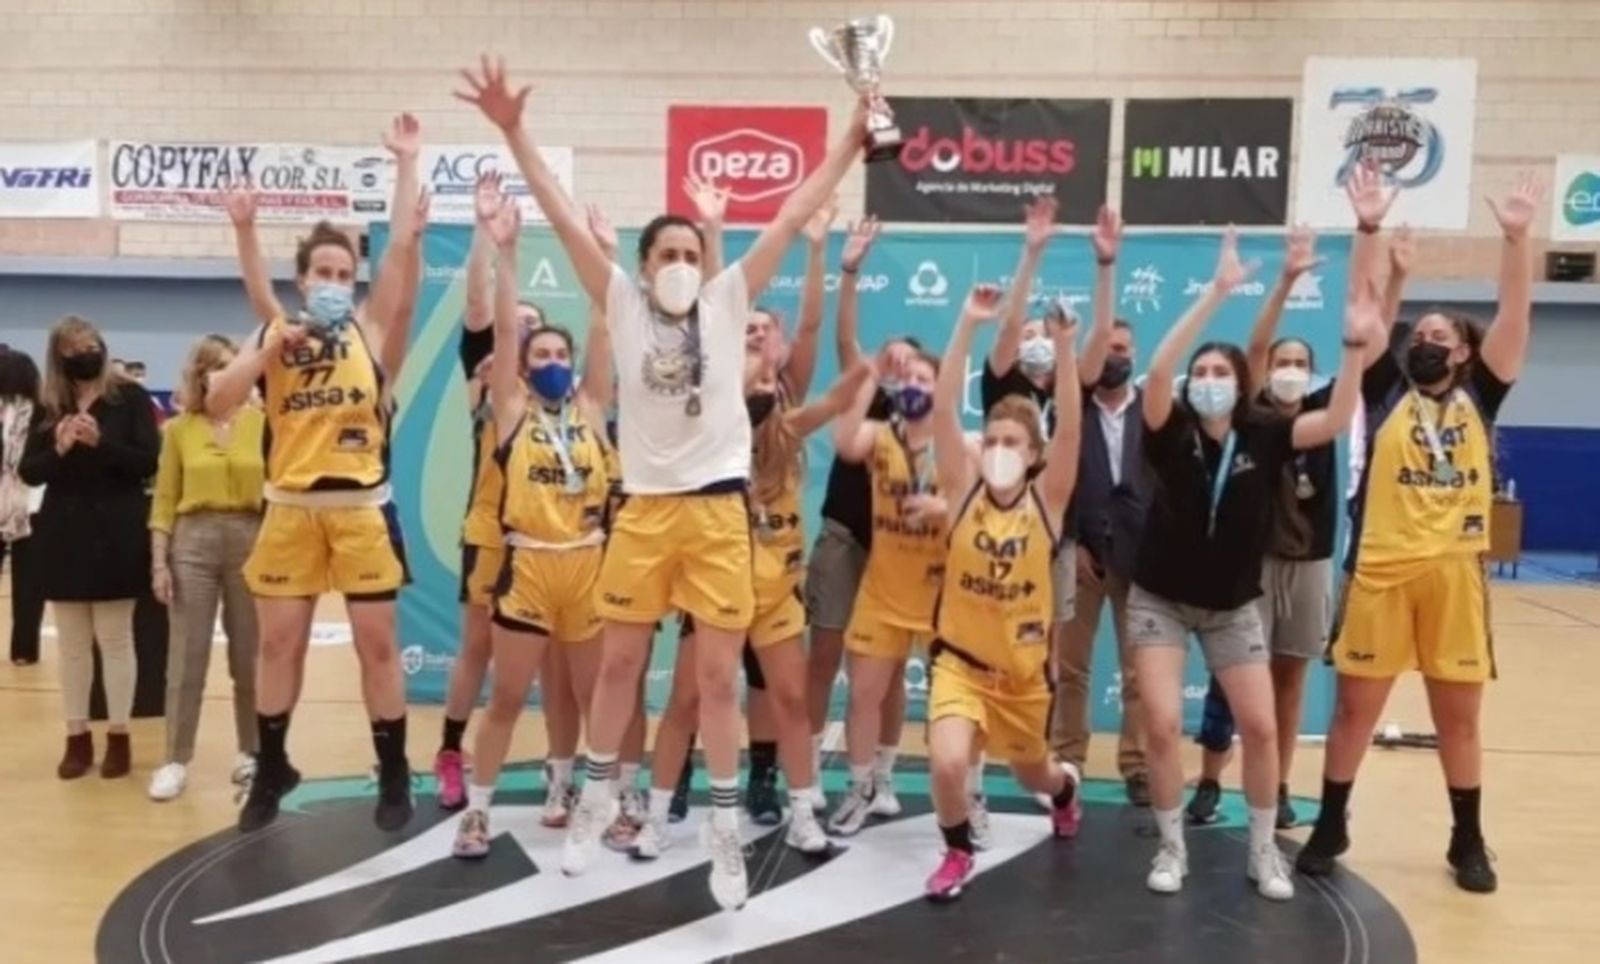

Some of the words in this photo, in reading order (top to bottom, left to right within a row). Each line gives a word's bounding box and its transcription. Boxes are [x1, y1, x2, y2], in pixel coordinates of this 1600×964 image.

[900, 125, 1076, 172] dobuss
[111, 143, 258, 190] COPYFAX
[701, 152, 790, 181] peza
[1168, 146, 1279, 178] MILAR
[957, 182, 969, 193] de
[971, 181, 1020, 195] Marketing
[1023, 181, 1056, 196] Digital
[824, 274, 889, 292] CAP
[300, 364, 335, 388] 77
[1411, 422, 1467, 447] CAT
[1398, 465, 1479, 489] asia+
[989, 560, 1012, 580] 17
